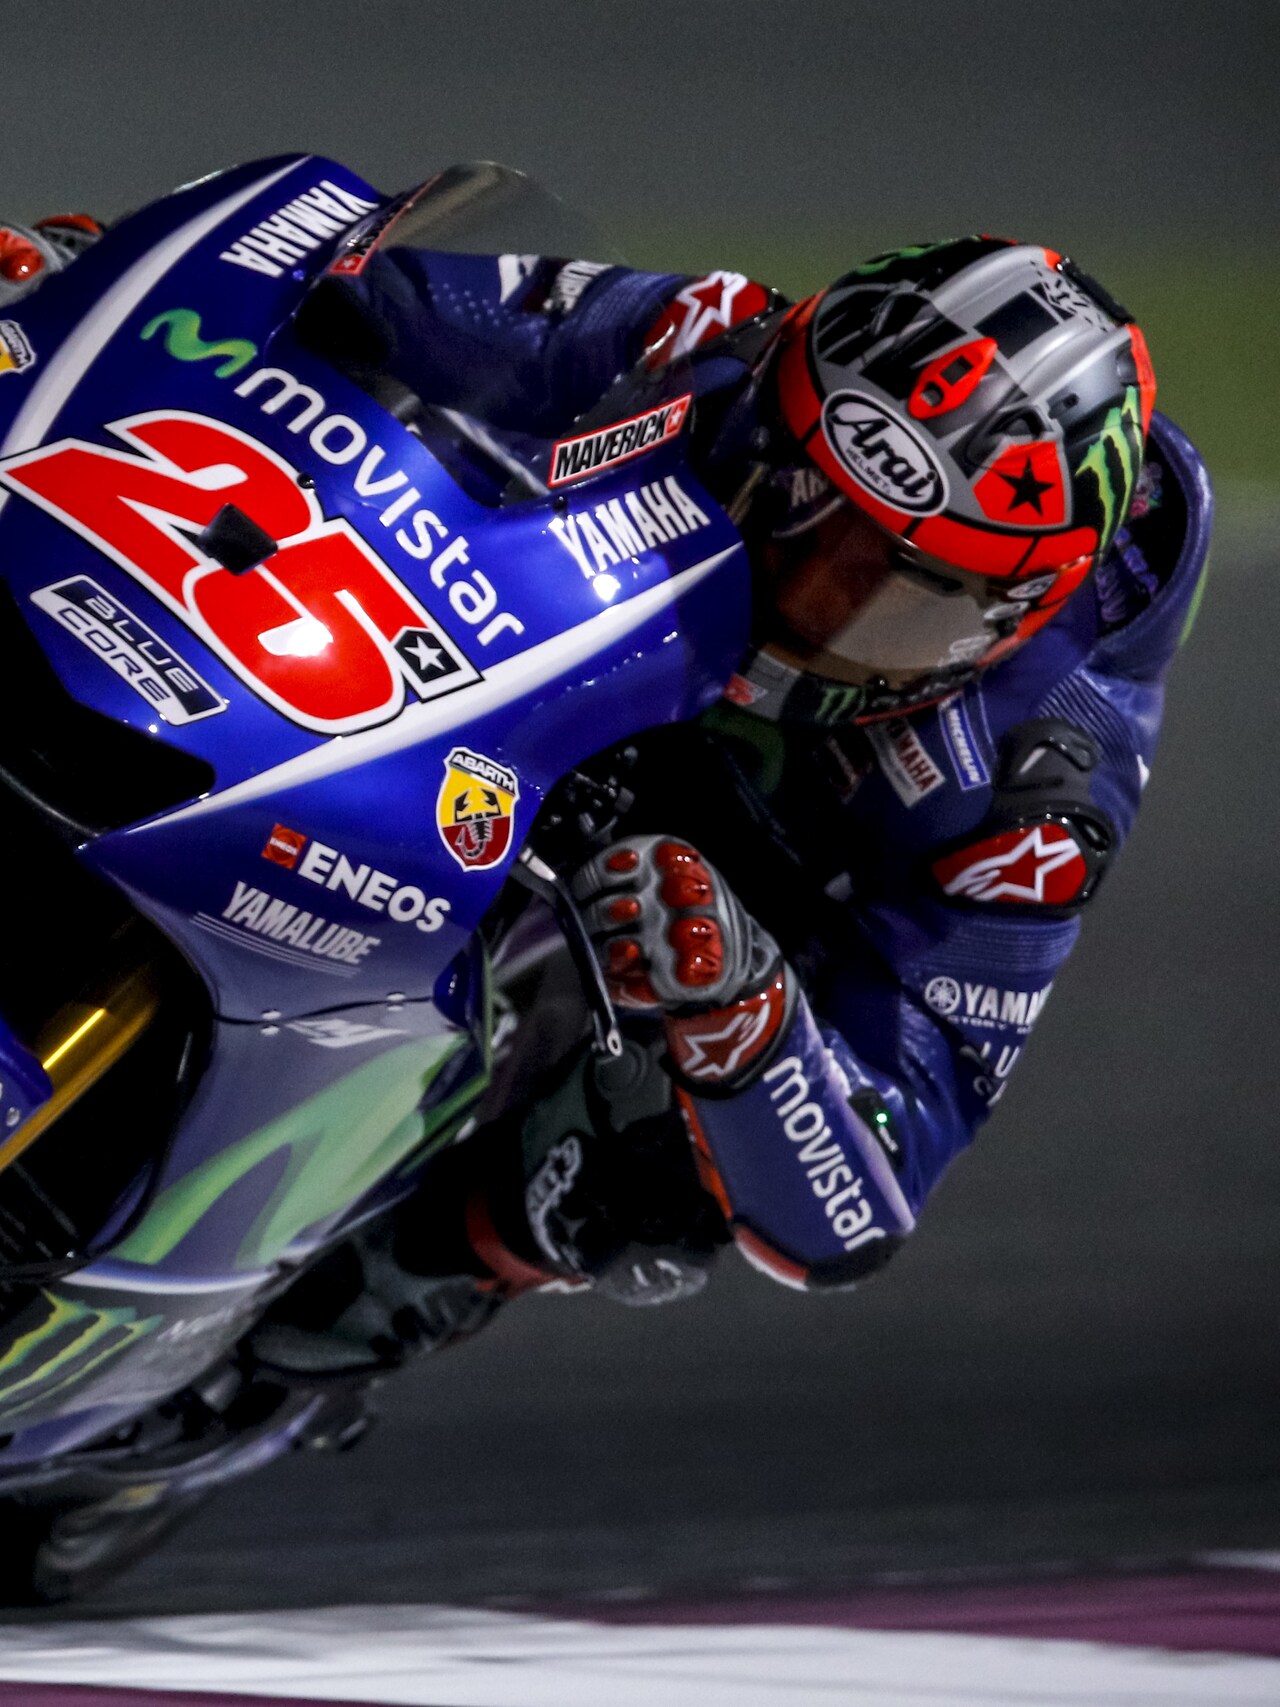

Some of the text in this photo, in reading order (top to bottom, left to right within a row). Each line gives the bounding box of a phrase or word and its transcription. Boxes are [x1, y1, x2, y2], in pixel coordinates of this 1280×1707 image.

[220, 180, 379, 277] YAMAHA
[555, 408, 670, 480] MAVERICK
[828, 418, 936, 497] Arai
[234, 368, 525, 646] movistar
[548, 475, 710, 579] YAMAHA
[58, 608, 171, 701] CORE
[84, 594, 199, 692] BLUE
[452, 753, 514, 790] ABARTH
[221, 880, 381, 964] YAMALUBE
[297, 840, 451, 933] ENEOS
[763, 1056, 887, 1251] movistar
